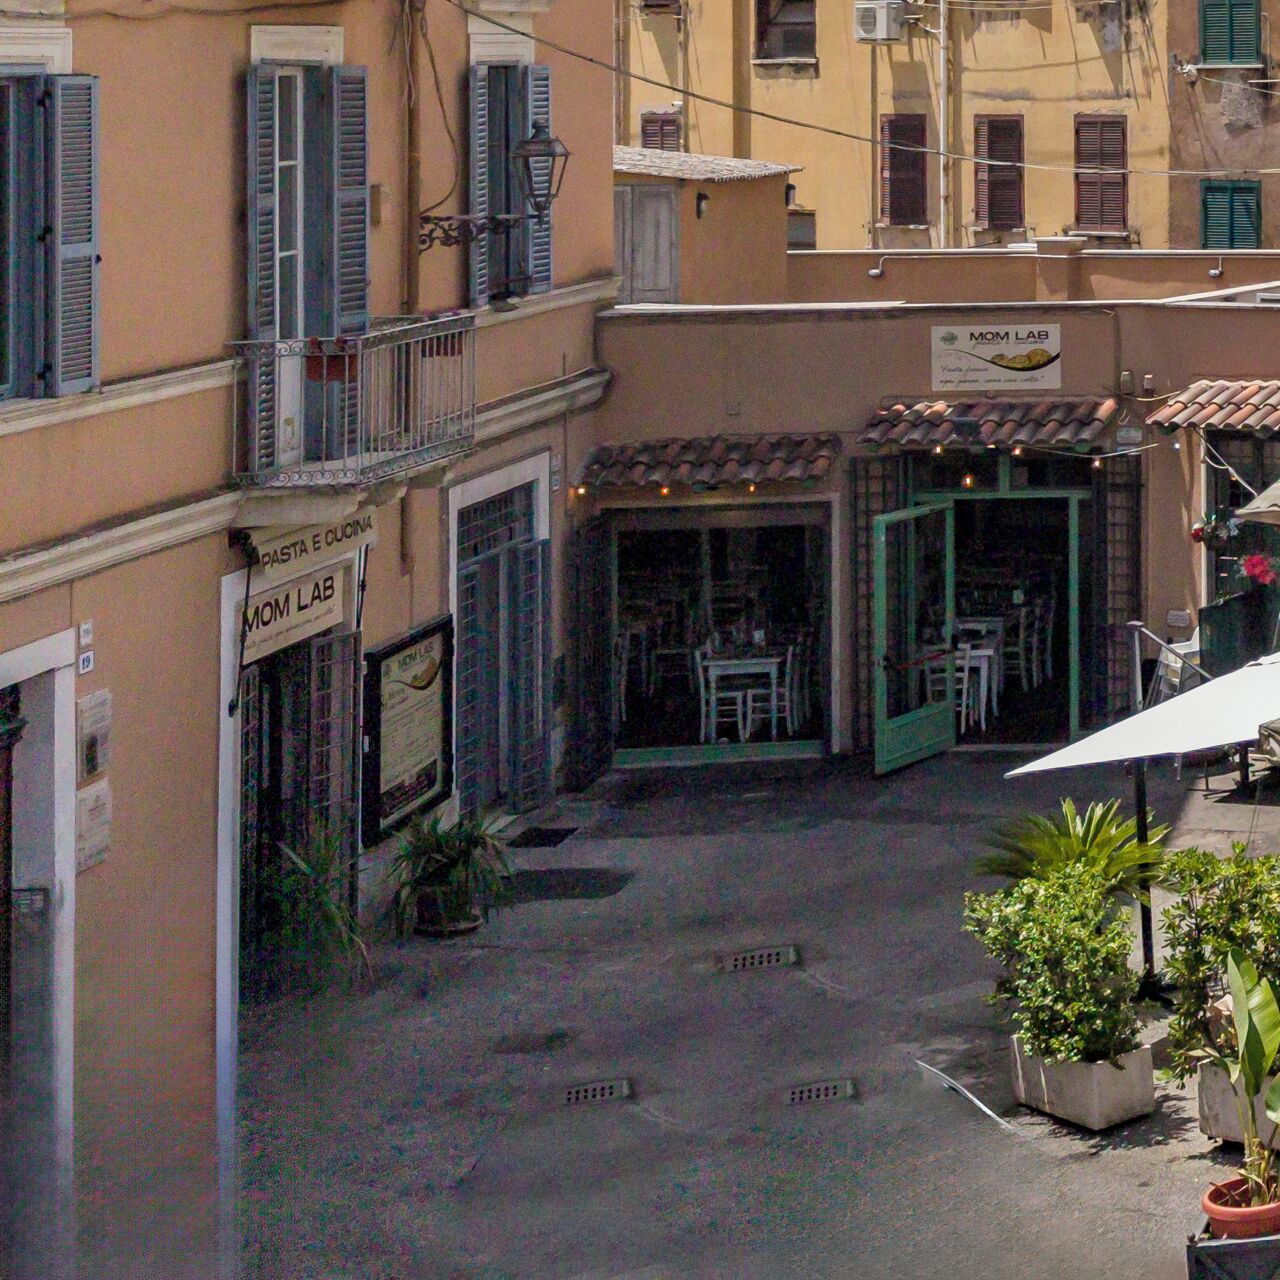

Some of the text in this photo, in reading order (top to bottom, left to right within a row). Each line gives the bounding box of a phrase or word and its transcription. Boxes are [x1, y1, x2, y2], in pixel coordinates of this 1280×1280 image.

[969, 331, 1010, 341] MOM
[1015, 330, 1049, 340] LAB
[261, 515, 373, 570] PASTA E CUCINA
[243, 592, 290, 633] MOM
[297, 575, 335, 613] LAB
[82, 655, 91, 670] 19
